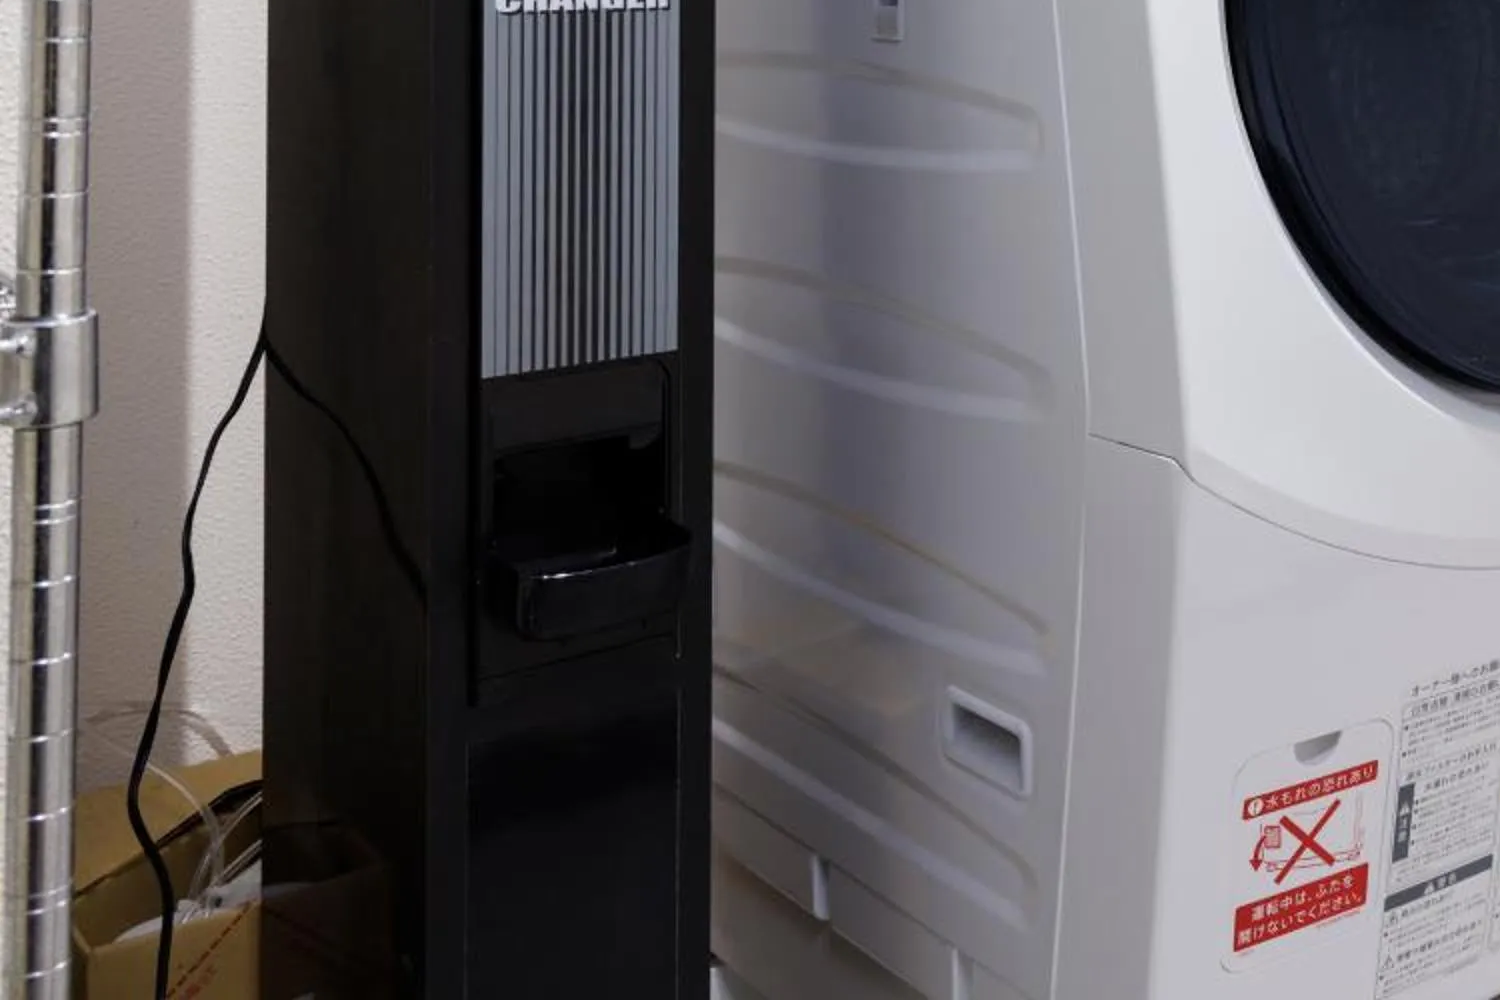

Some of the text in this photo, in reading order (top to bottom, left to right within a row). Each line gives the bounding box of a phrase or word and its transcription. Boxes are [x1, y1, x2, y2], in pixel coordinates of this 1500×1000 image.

[1265, 765, 1375, 810] 水もれの恐れあり
